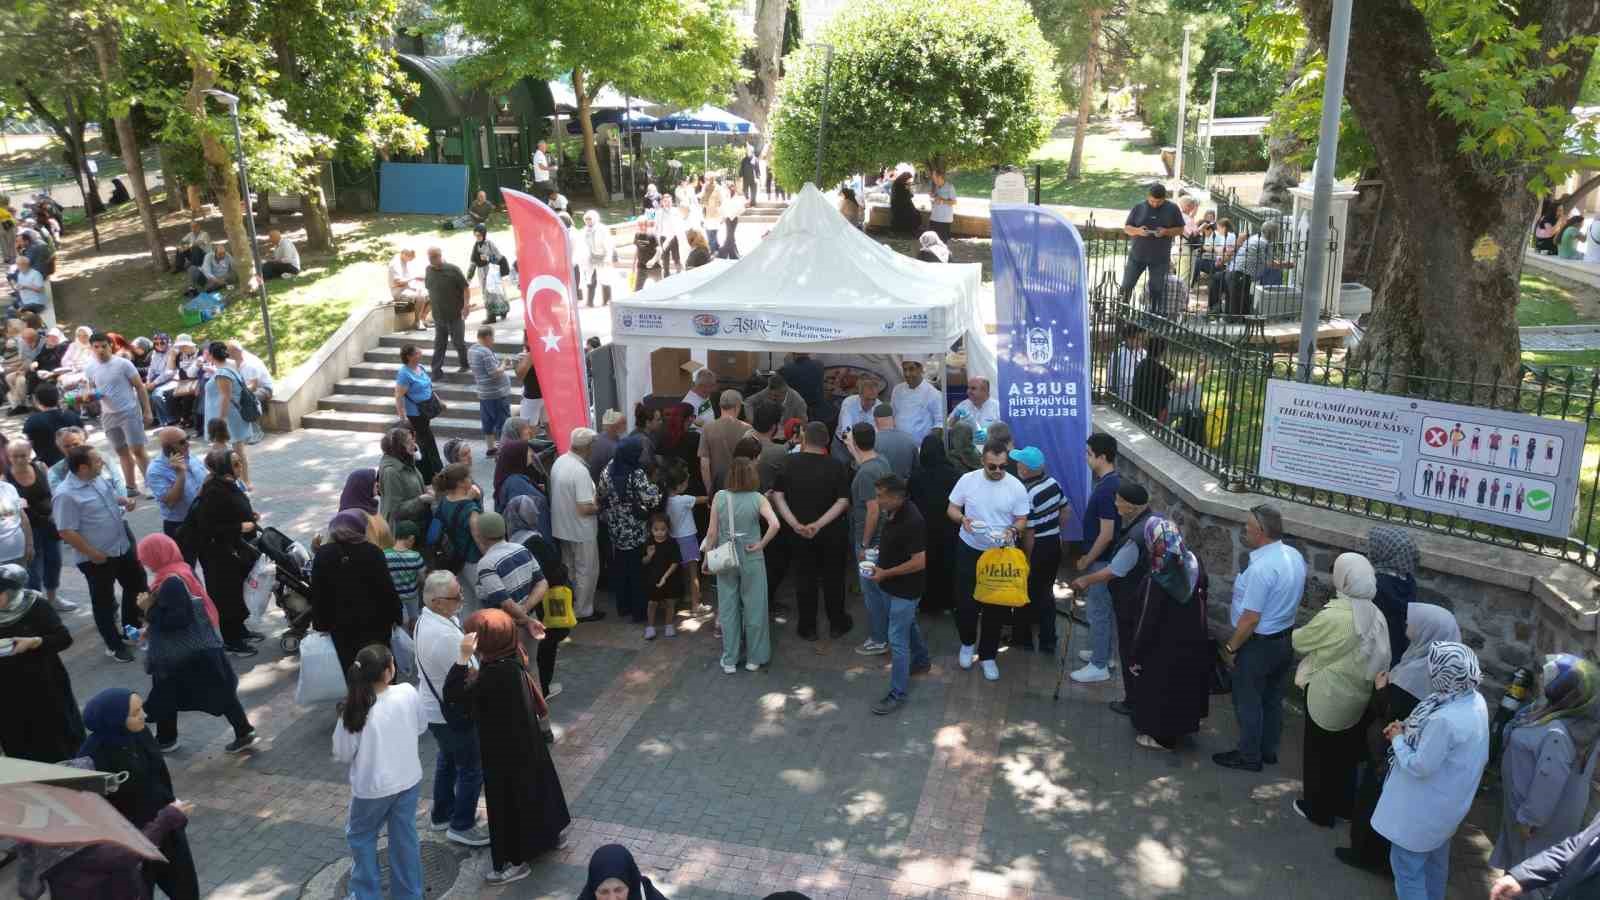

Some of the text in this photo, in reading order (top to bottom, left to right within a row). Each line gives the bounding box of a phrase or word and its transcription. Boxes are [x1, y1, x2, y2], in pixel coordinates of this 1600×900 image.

[1293, 398, 1313, 406] ULU
[1314, 401, 1345, 413] CAMİİ
[1347, 405, 1380, 417] DİYOR
[1279, 407, 1298, 415] THE
[1300, 409, 1335, 422] GRAND
[1337, 414, 1382, 429] MOSQUE
